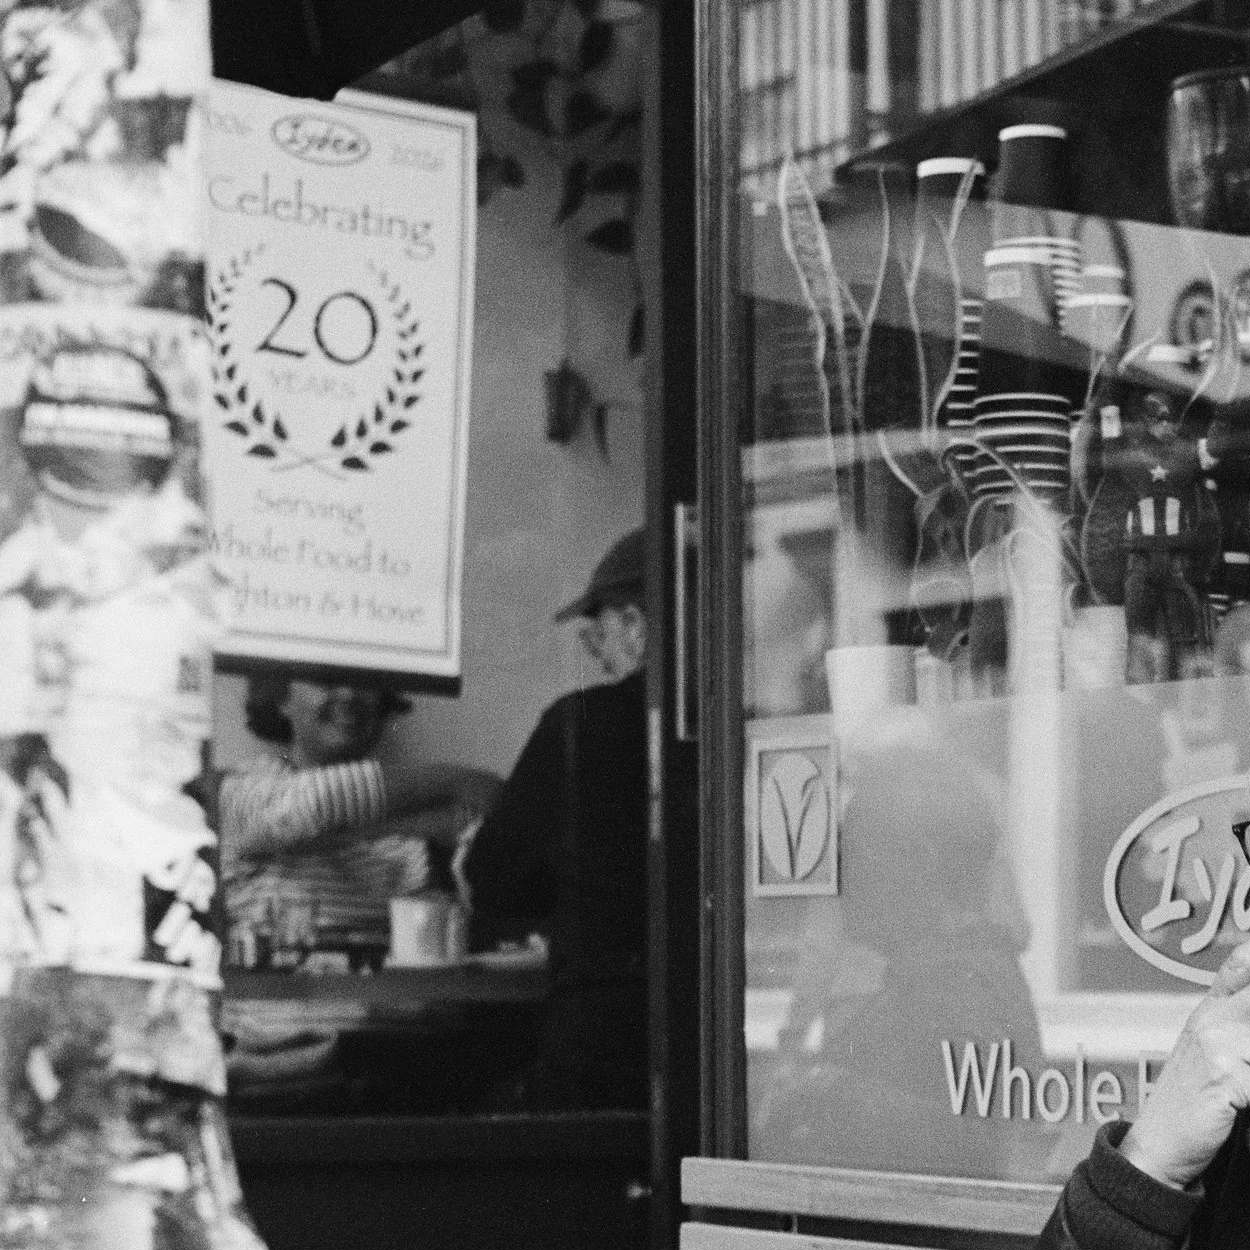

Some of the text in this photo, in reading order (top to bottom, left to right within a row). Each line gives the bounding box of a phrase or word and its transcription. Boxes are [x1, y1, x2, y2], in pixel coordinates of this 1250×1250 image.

[206, 172, 437, 261] Celebrating
[255, 276, 379, 366] 20
[267, 367, 357, 401] YEARS
[252, 488, 367, 537] Serving
[297, 538, 372, 574] Food
[378, 549, 411, 578] to
[318, 591, 343, 616] &
[350, 593, 425, 626] Hove
[941, 1038, 1123, 1124] Whole
